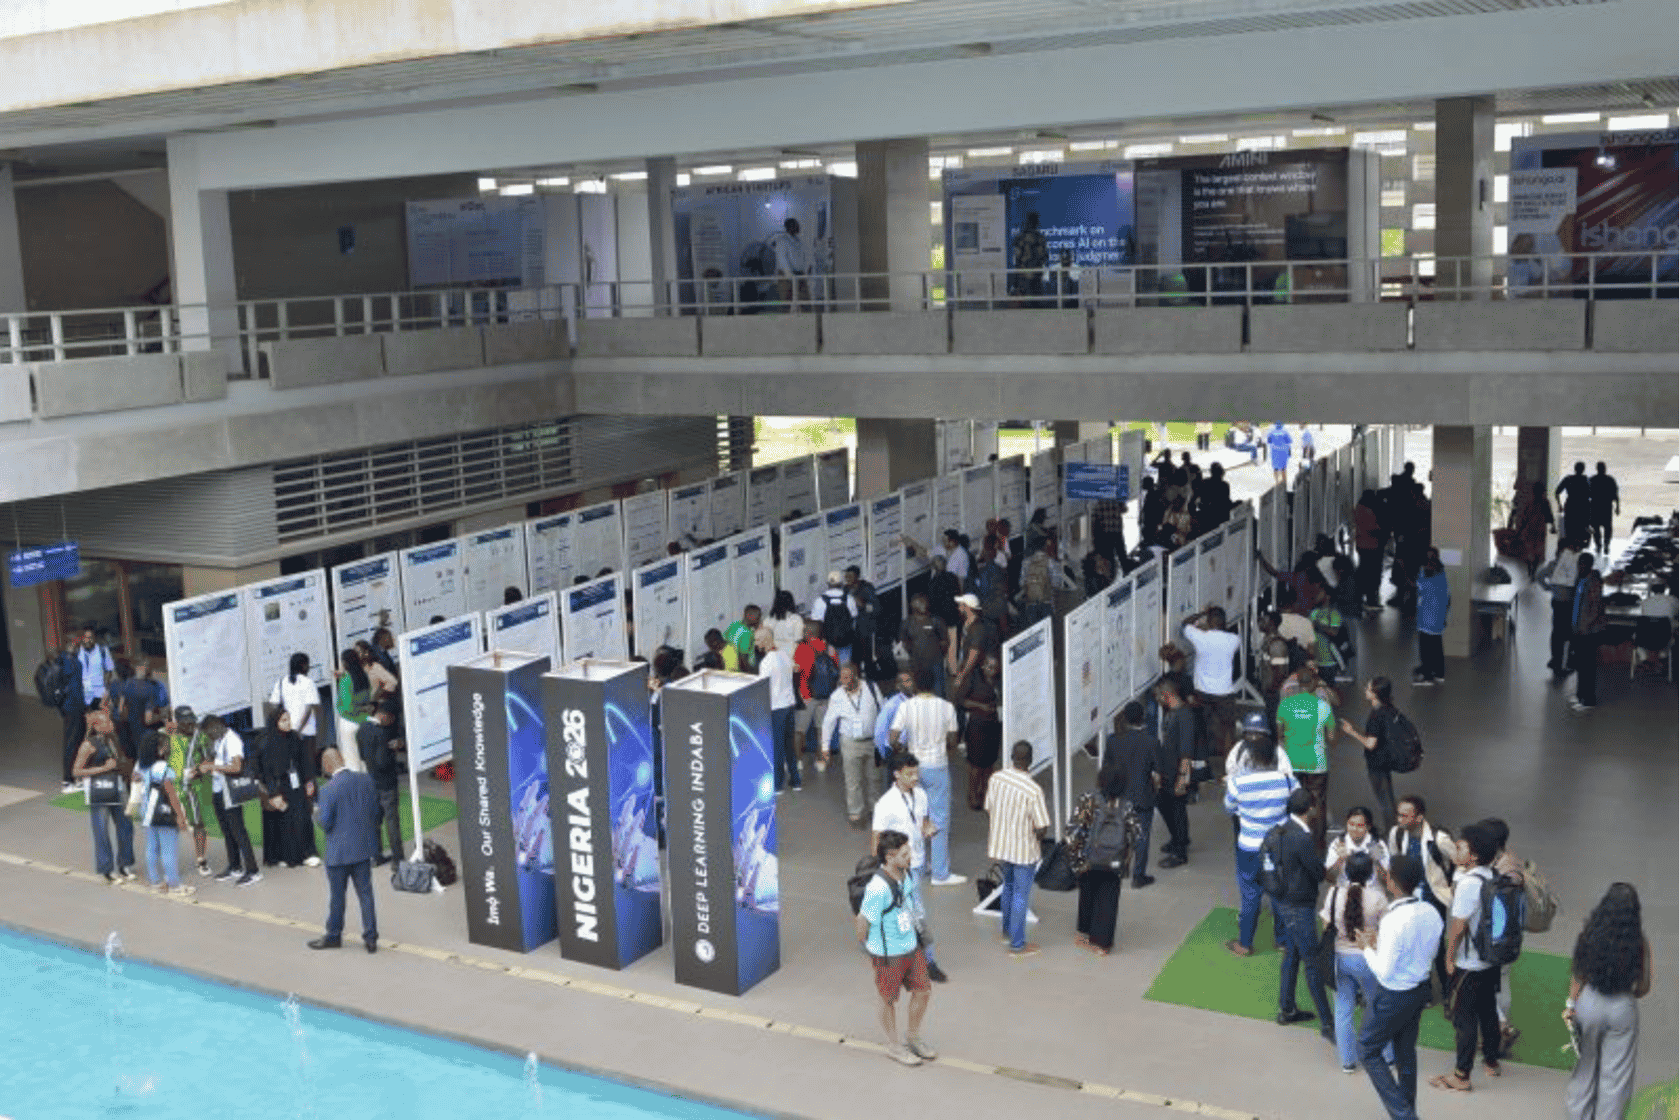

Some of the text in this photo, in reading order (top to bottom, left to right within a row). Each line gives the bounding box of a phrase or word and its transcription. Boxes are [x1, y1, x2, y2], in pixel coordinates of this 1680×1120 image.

[1219, 150, 1268, 168] AMINI
[1244, 172, 1277, 182] context
[1202, 188, 1216, 196] the
[1218, 188, 1235, 196] one
[1090, 226, 1105, 235] on
[1046, 240, 1075, 249] cores
[1078, 238, 1090, 248] AI
[1092, 239, 1107, 248] on
[472, 692, 486, 772] Knowledge
[477, 776, 491, 826] Shared
[689, 721, 709, 933] DEEP LEARNING INDABA
[481, 829, 493, 856] Our
[566, 786, 598, 942] NIGERIA
